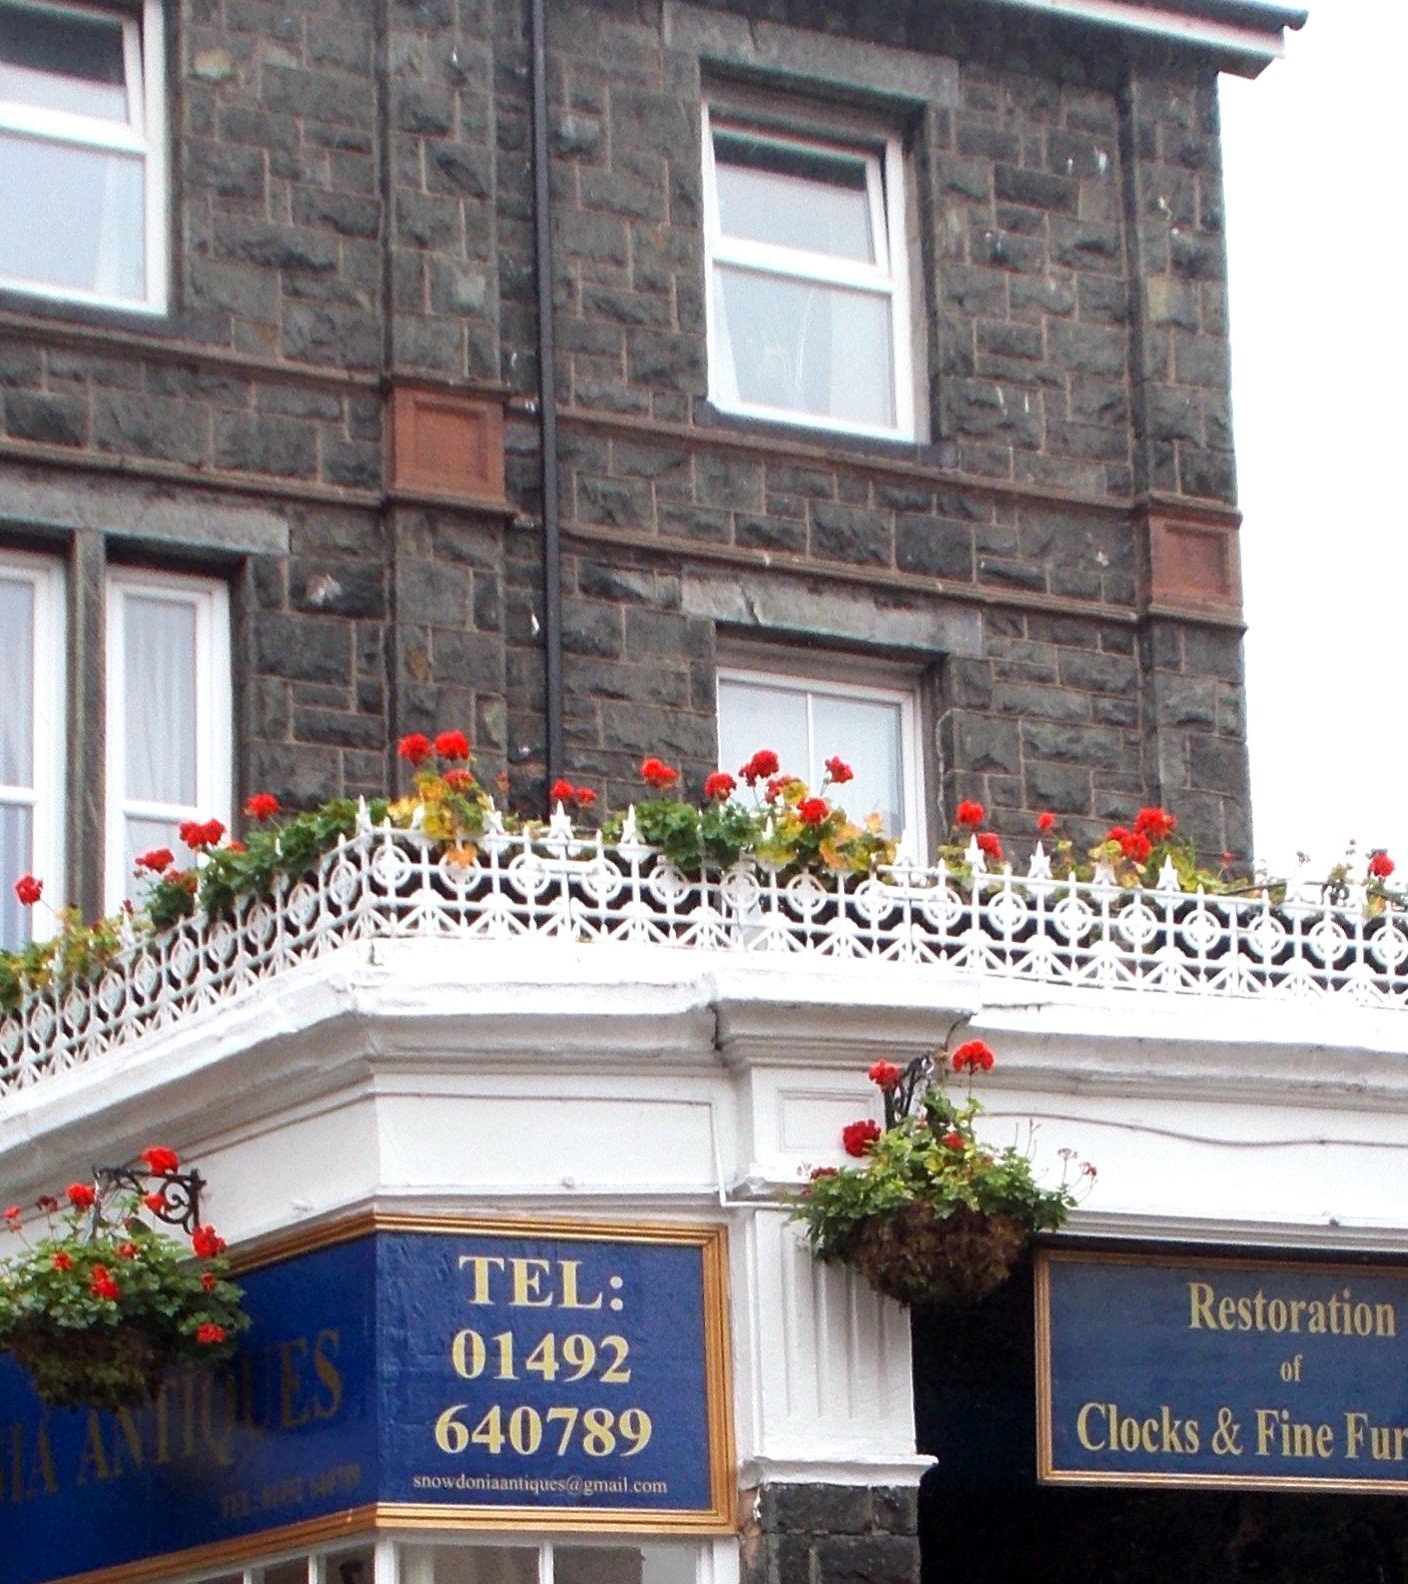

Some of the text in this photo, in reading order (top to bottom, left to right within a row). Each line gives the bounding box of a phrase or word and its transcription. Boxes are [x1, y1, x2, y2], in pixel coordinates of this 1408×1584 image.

[458, 1255, 624, 1311] TEL:
[1188, 1281, 1396, 1338] Restoration
[452, 1329, 632, 1383] 01492
[1280, 1353, 1303, 1383] of
[435, 1404, 653, 1457] 640789
[1077, 1401, 1200, 1454] Clocks
[1211, 1407, 1244, 1456] &
[1255, 1409, 1334, 1460] Fine
[412, 1471, 668, 1496] snowdoniaantiques@gmail.com
